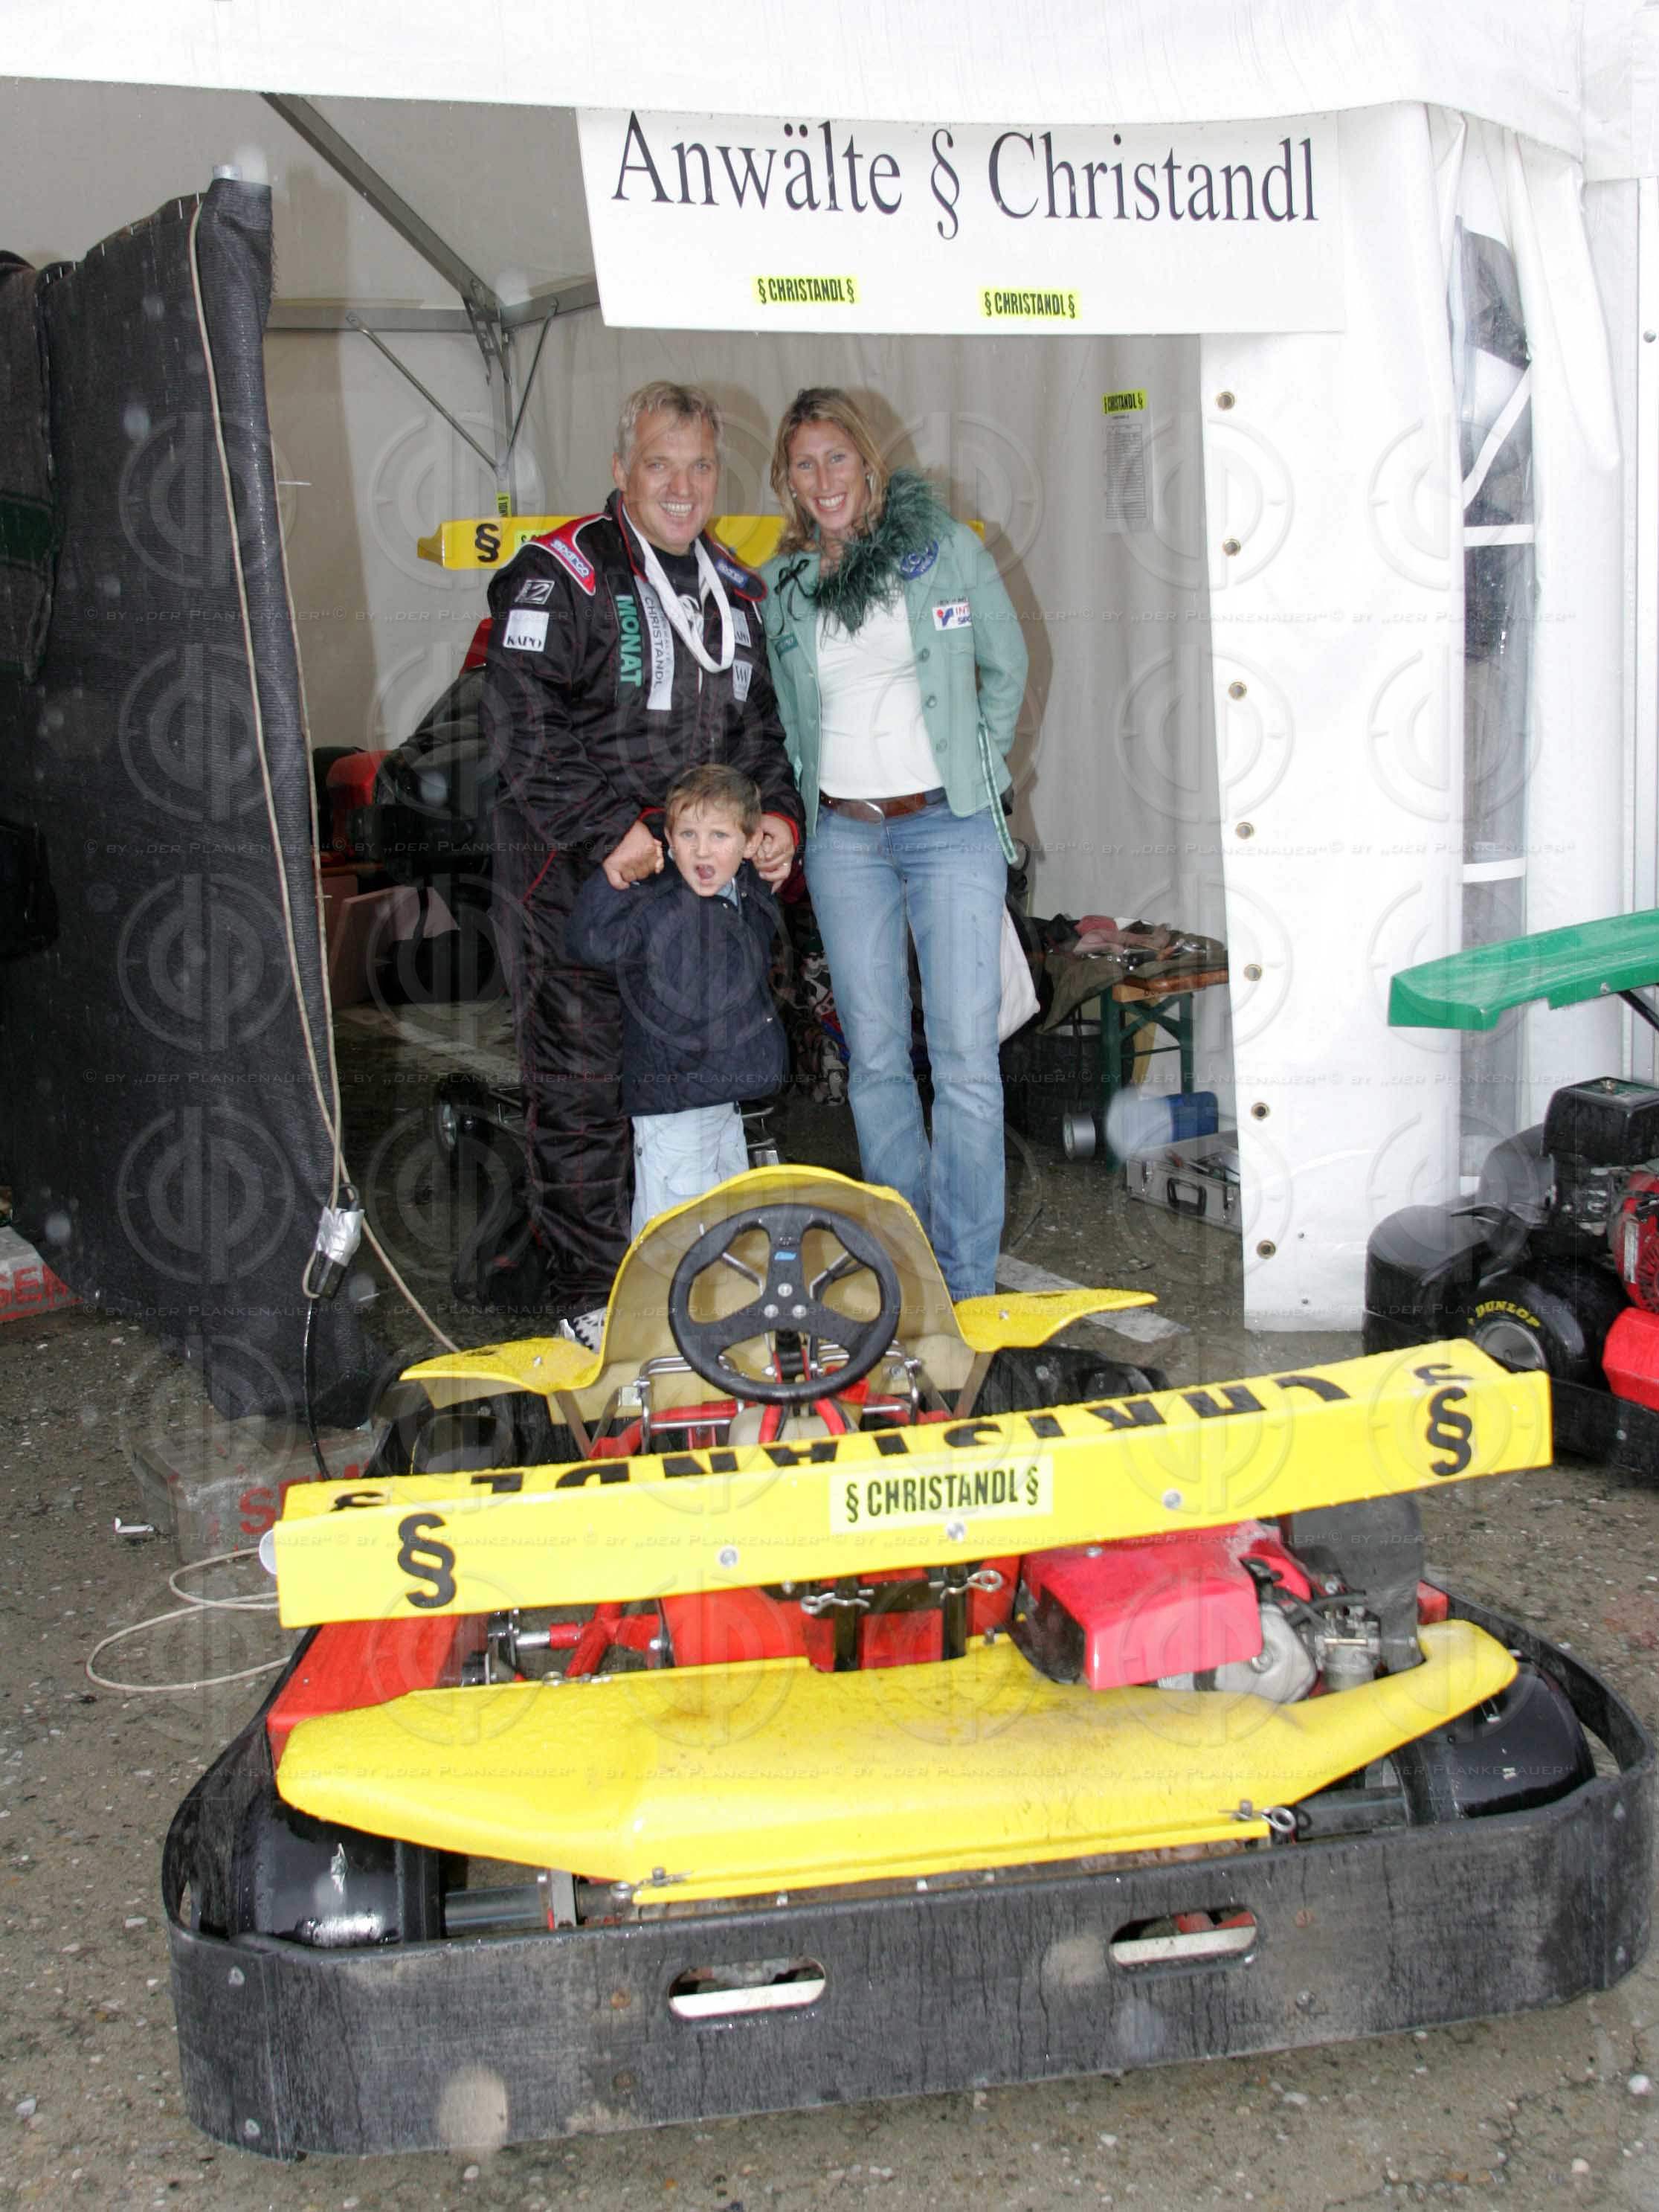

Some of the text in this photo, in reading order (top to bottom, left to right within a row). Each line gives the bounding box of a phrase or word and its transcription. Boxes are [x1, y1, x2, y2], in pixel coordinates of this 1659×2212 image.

[611, 109, 903, 215] Anwälte
[988, 130, 1320, 224] Christandl
[768, 278, 845, 301] CHRISTANDL
[994, 292, 1065, 316] CHRISTANDL
[615, 594, 642, 688] MONAT
[644, 597, 664, 689] CHRISTANDL
[1475, 1300, 1542, 1328] DUNLOP
[867, 1468, 1019, 1517] CHRISTANDL
